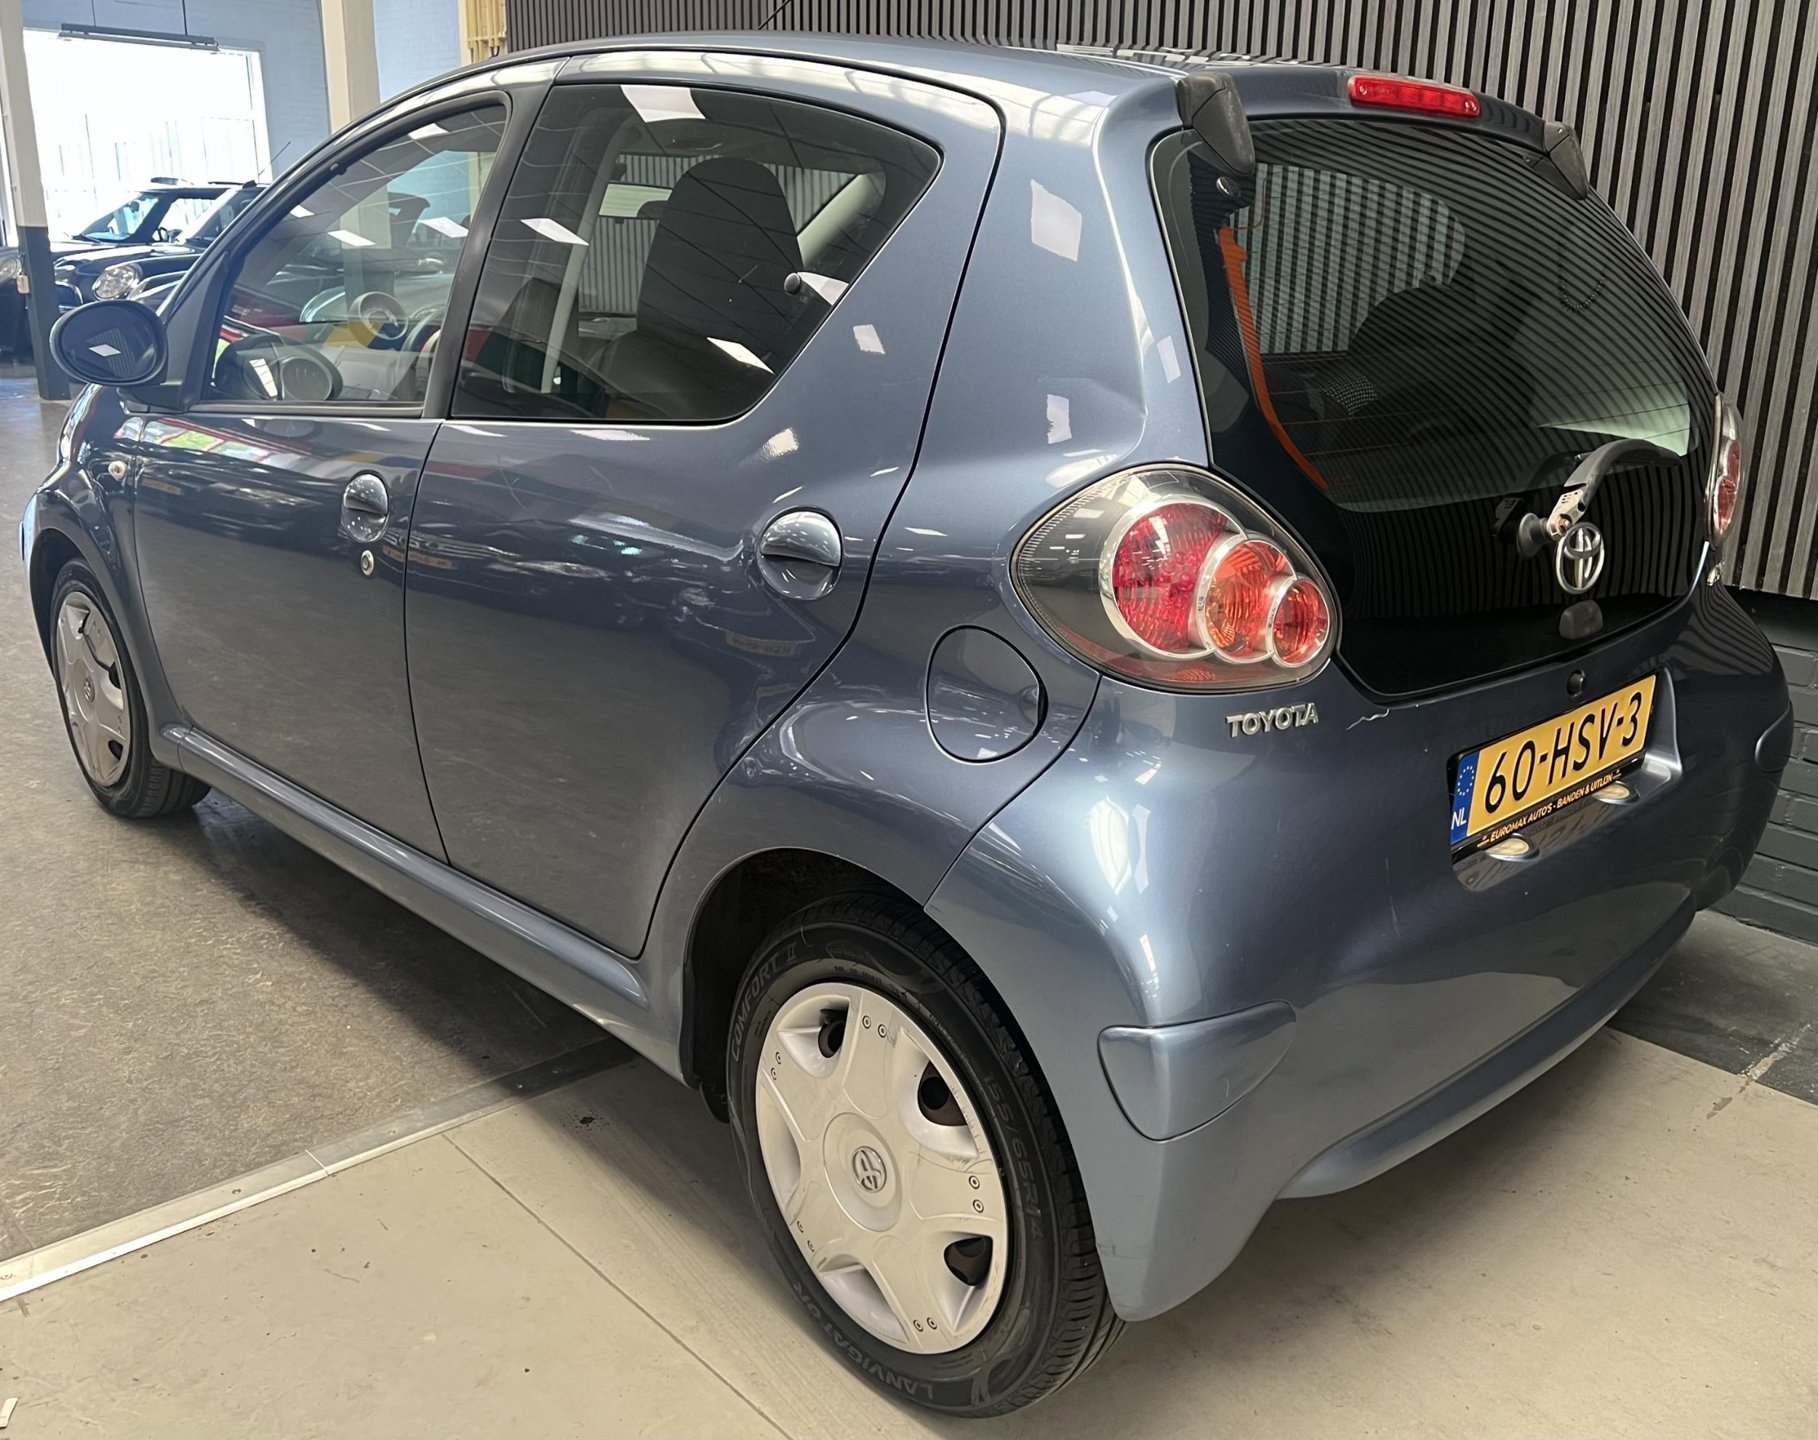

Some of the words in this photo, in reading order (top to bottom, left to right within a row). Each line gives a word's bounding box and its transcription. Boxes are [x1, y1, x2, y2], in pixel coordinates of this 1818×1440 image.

[1226, 702, 1319, 738] TOYOTA
[1484, 691, 1642, 814] 60-HSV-3
[1451, 806, 1467, 831] NL
[1490, 815, 1528, 842] EUROMAX
[1556, 787, 1585, 809] BANDEN
[731, 952, 781, 1063] COMFORT
[982, 1070, 1043, 1239] 155/65R14
